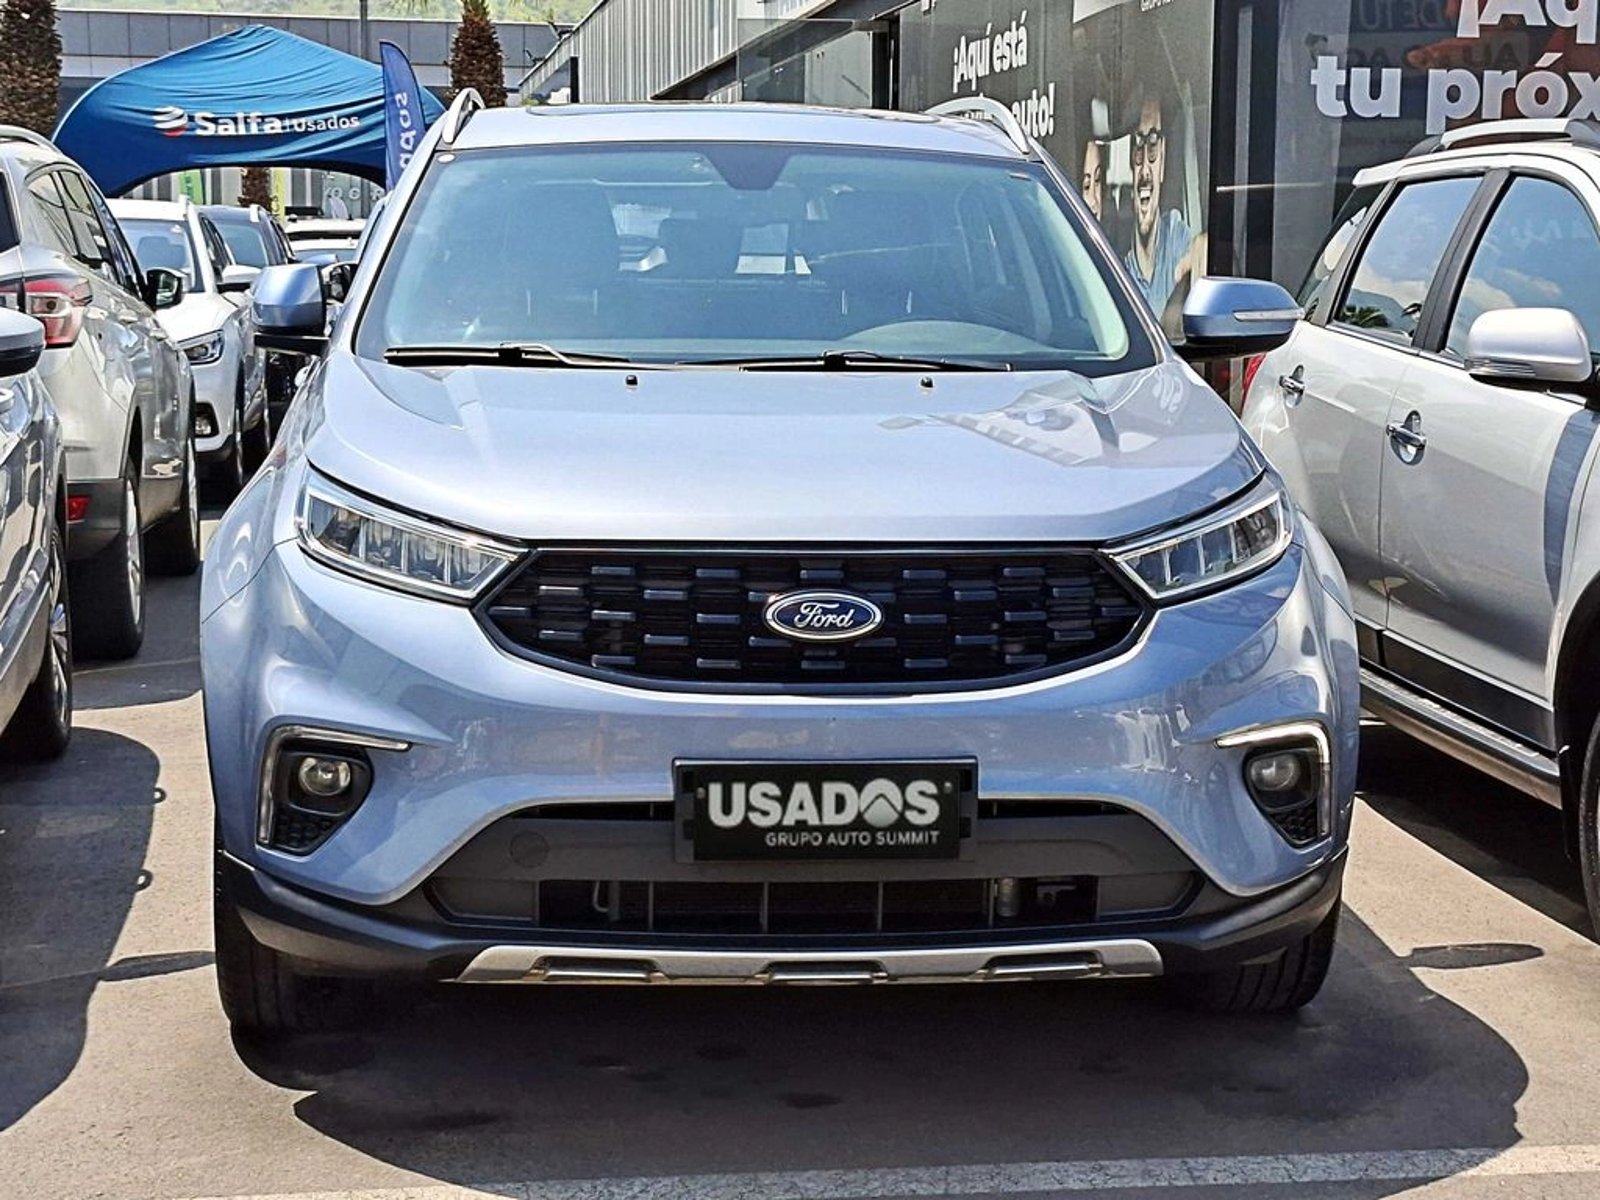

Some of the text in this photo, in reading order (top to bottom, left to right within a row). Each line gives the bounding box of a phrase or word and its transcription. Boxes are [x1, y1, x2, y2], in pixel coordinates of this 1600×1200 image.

[953, 10, 1028, 94] ¡Aquí está
[1310, 52, 1600, 135] tu próx
[193, 111, 361, 136] Salfa Usados
[794, 602, 855, 628] Ford
[708, 778, 941, 828] USADOS
[765, 830, 941, 846] GRUPO AUTO SUMMIT
